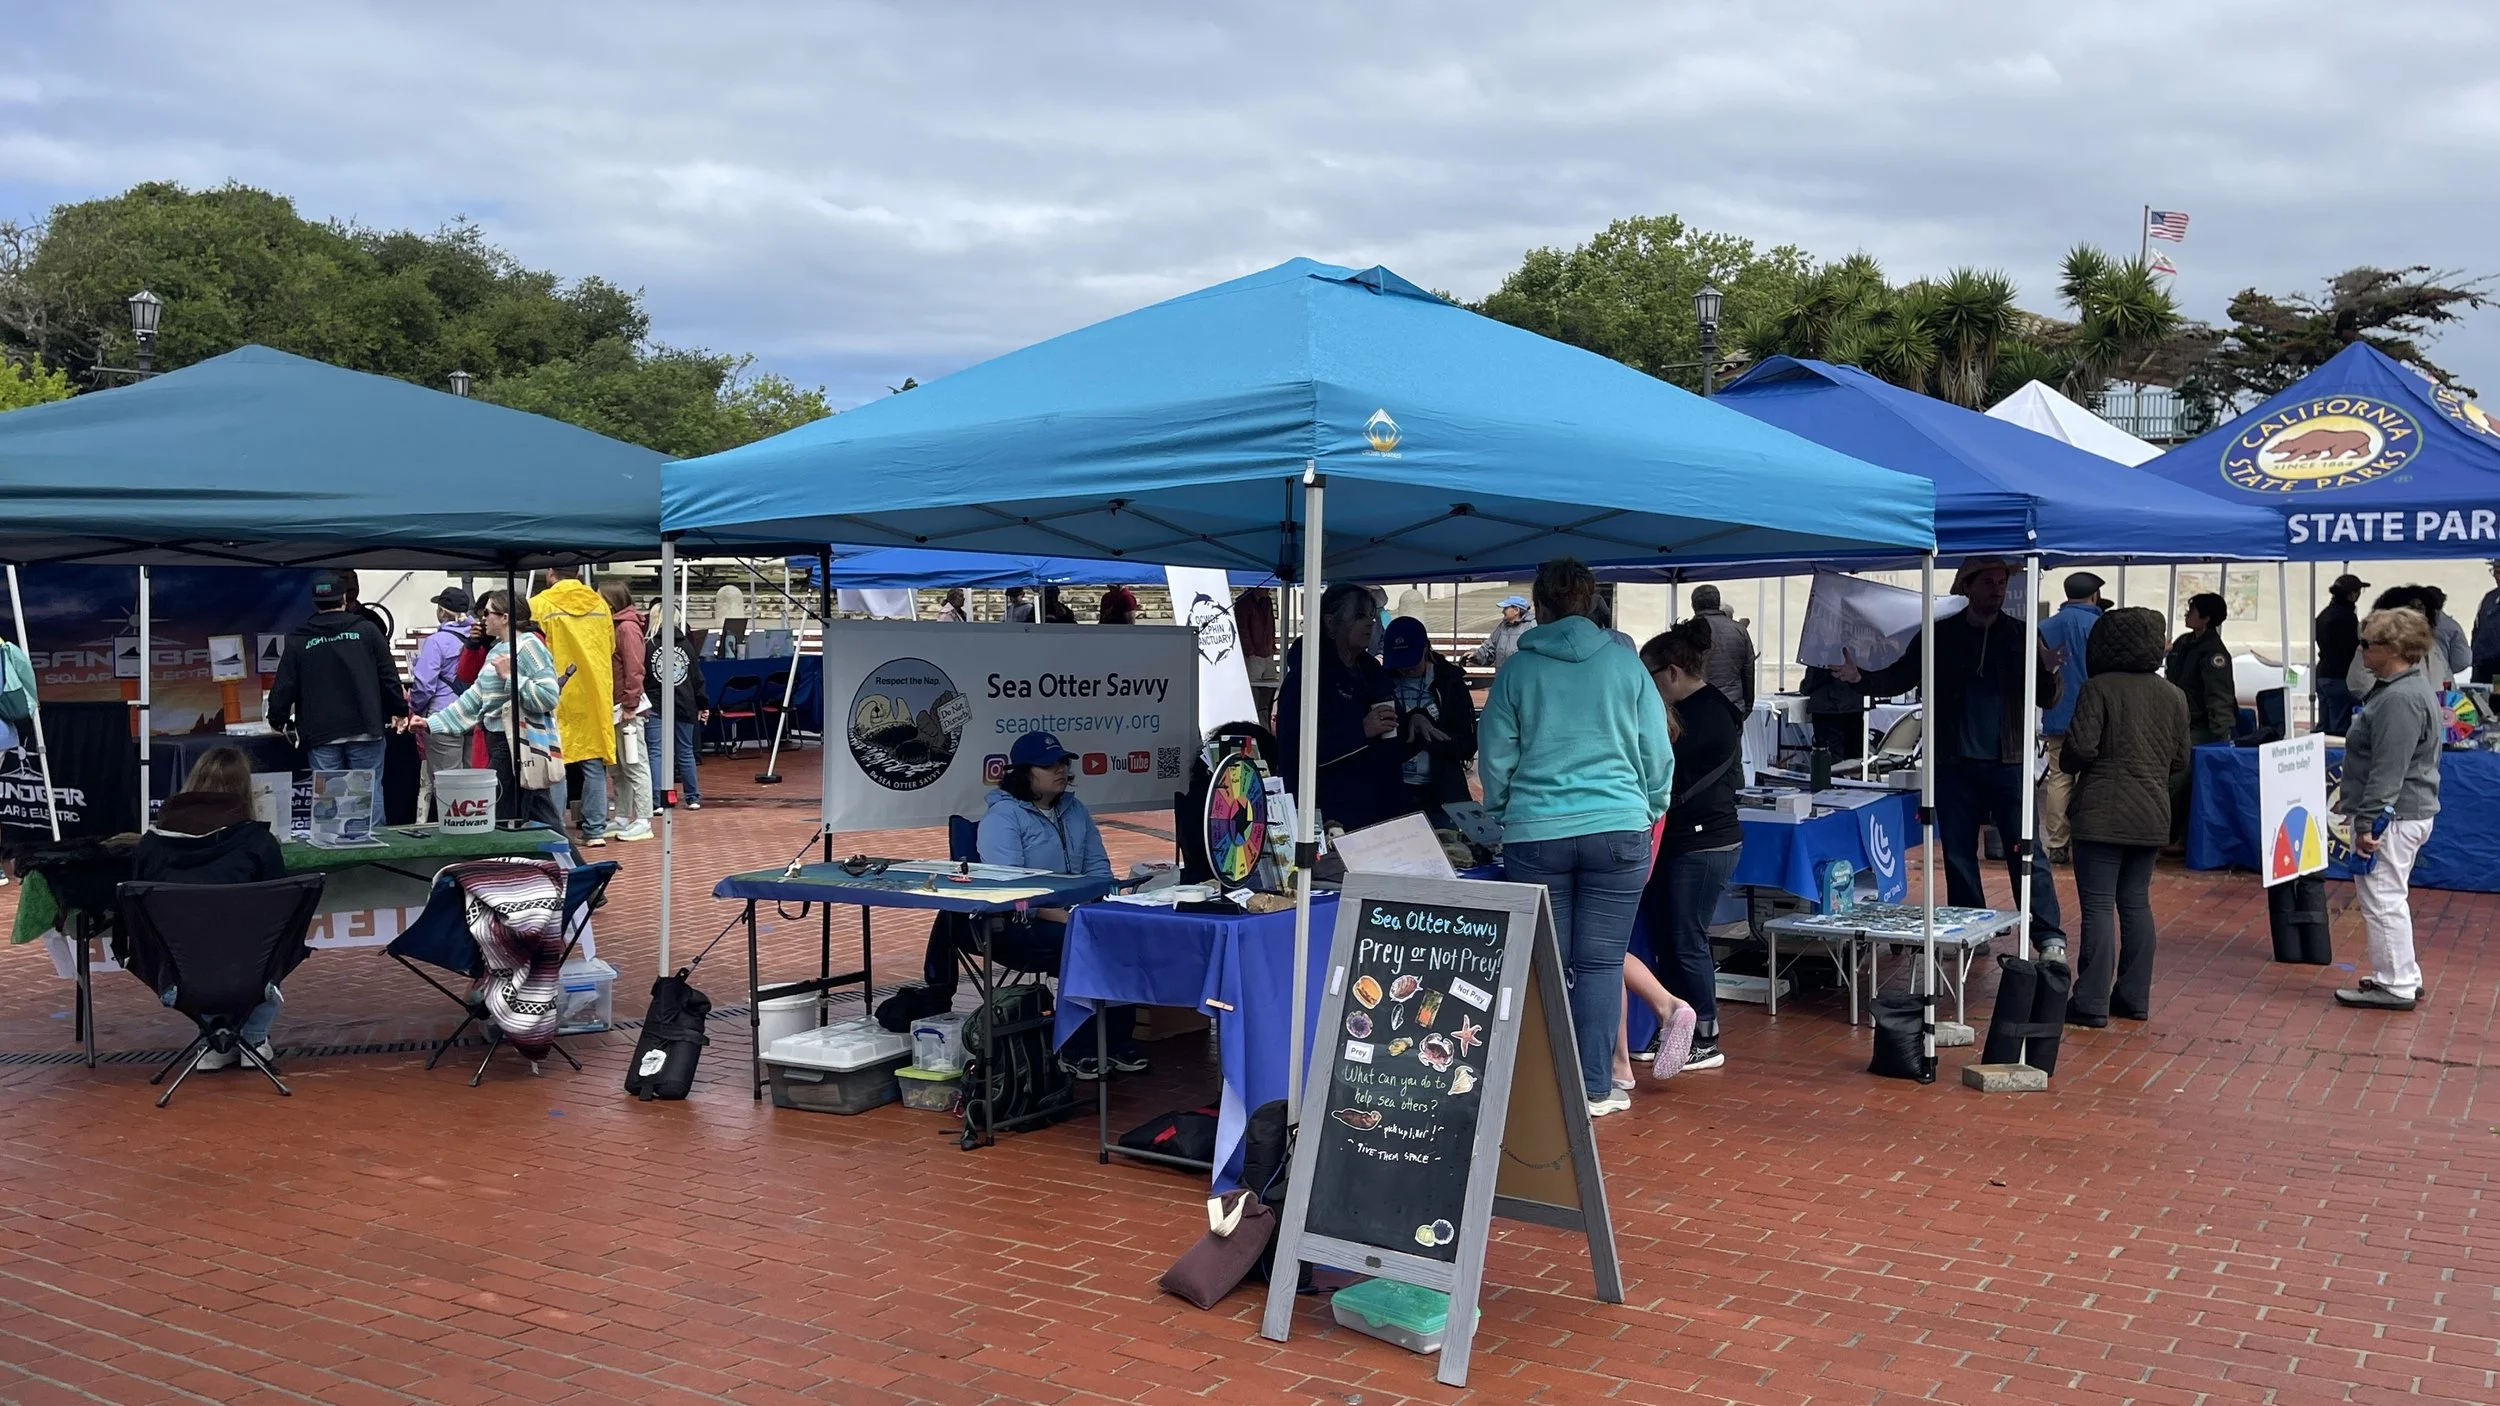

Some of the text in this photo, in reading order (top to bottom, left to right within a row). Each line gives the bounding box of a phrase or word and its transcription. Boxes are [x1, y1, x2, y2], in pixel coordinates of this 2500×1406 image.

[2242, 399, 2412, 449] CALIFORNIA
[2229, 449, 2407, 492] STATE PARKS
[2273, 461, 2316, 471] SINCE
[2288, 511, 2404, 544] STATE
[1199, 634, 1231, 646] ANCTUARY
[875, 676, 908, 687] Respect
[910, 676, 922, 685] the
[987, 672, 1170, 703] Sea Otter Savvy
[941, 710, 952, 719] Do
[995, 712, 1160, 734] seaottersavvy.org
[1110, 754, 1150, 771] YouTube
[878, 776, 891, 787] SEA
[893, 781, 918, 789] OTTER
[919, 769, 941, 786] SAVVY
[444, 799, 489, 818] ACE
[443, 818, 489, 828] Hardware
[1370, 907, 1402, 930] Sea
[1406, 910, 1451, 935] Otter
[1358, 937, 1504, 982] Prey or Not Prey?
[1456, 984, 1486, 1005] Not Prey
[1350, 1047, 1368, 1058] Prey
[1344, 1064, 1446, 1097] What can you do to
[1354, 1087, 1373, 1106] help
[1377, 1094, 1396, 1108] sea
